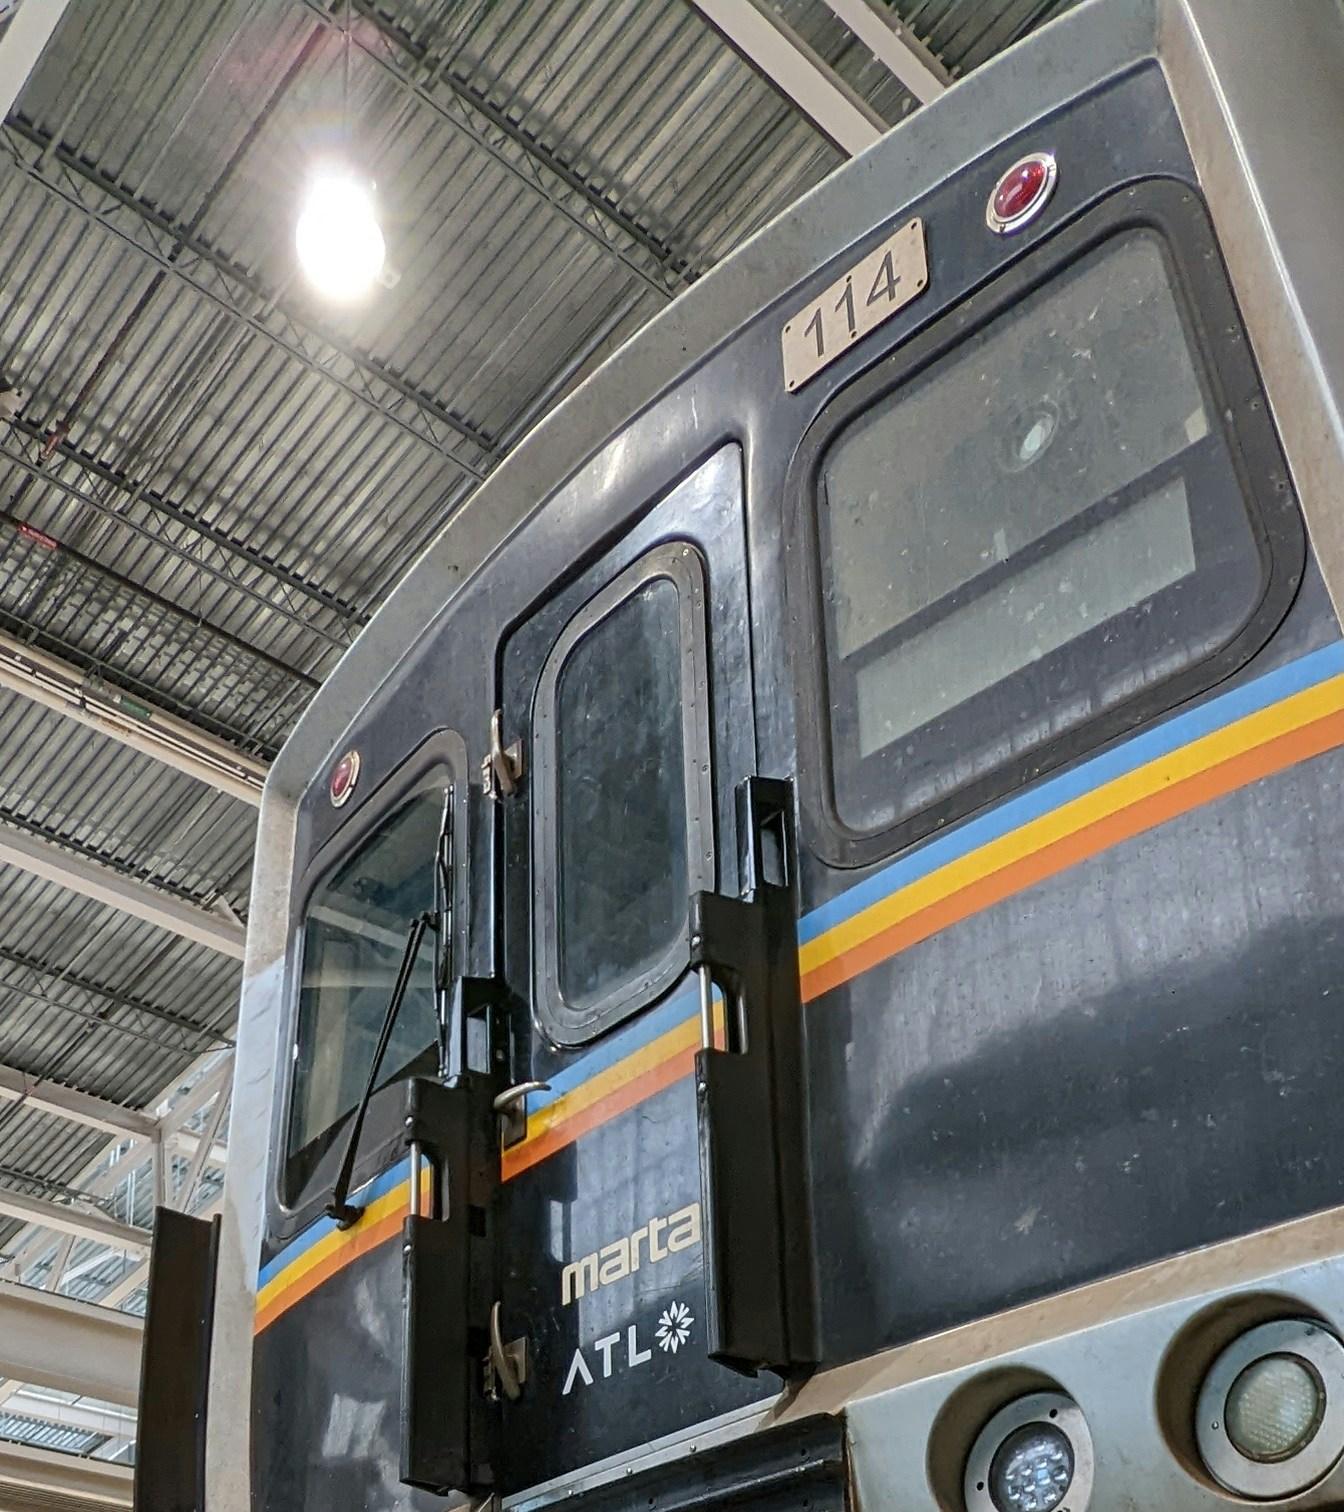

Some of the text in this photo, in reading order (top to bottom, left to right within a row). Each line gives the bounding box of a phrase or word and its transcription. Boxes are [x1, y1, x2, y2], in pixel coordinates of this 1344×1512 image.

[803, 250, 902, 358] 114
[561, 1202, 702, 1306] marta
[562, 1324, 652, 1396] ATL
